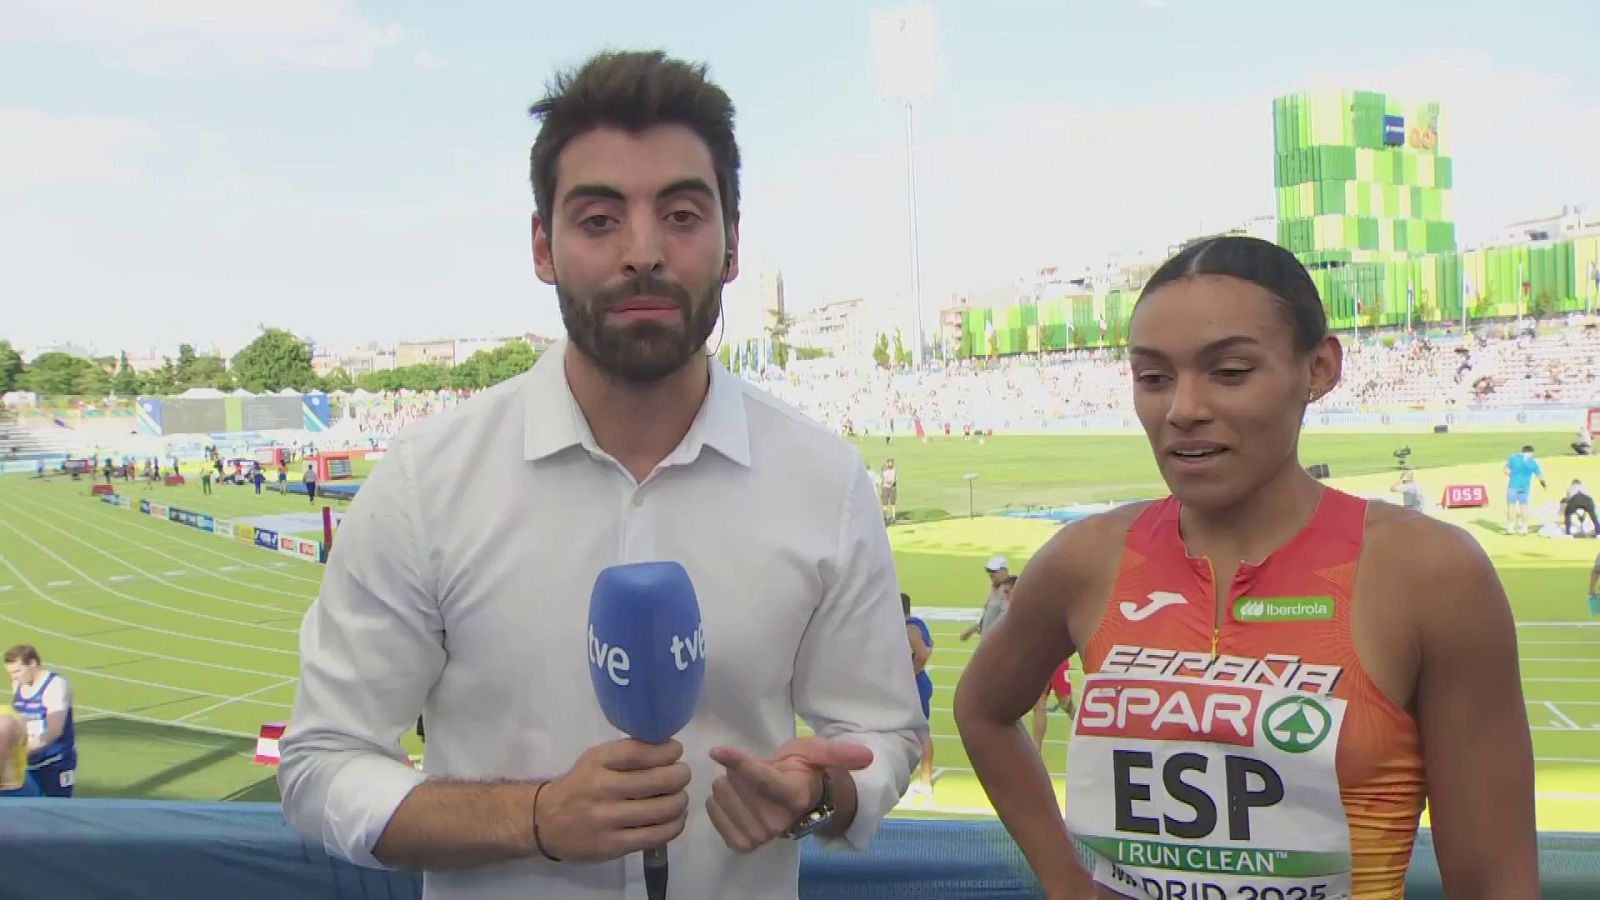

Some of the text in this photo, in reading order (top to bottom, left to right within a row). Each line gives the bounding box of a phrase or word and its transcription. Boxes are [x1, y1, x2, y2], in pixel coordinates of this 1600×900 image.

[1266, 602, 1328, 616] Iberdrola
[588, 624, 631, 686] tve
[1099, 644, 1344, 695] ESPAÑA
[1081, 687, 1252, 737] SPAR
[1113, 749, 1285, 841] ESP
[1118, 841, 1124, 861] I
[1129, 844, 1181, 867] RUN
